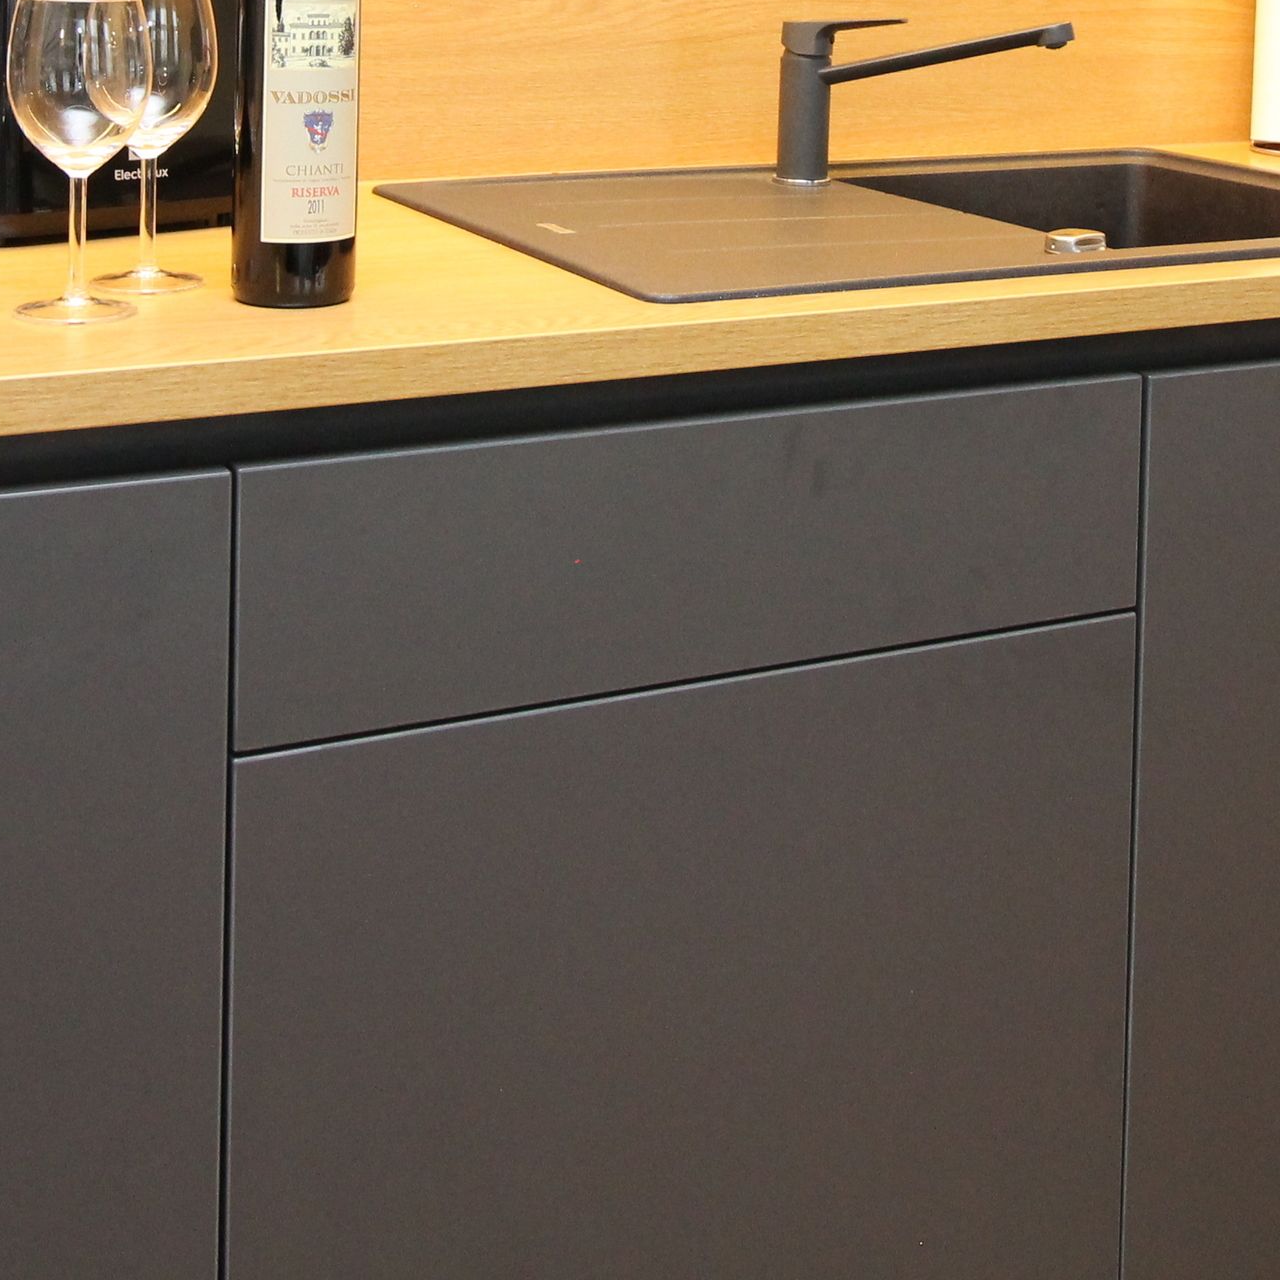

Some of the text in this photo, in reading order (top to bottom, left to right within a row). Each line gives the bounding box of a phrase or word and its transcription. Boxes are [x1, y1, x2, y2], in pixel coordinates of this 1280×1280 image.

[271, 88, 356, 104] VADOSSI
[114, 167, 169, 181] Electux
[285, 163, 345, 176] CHIANTI
[291, 185, 340, 198] RISERVA
[307, 199, 325, 215] 2011
